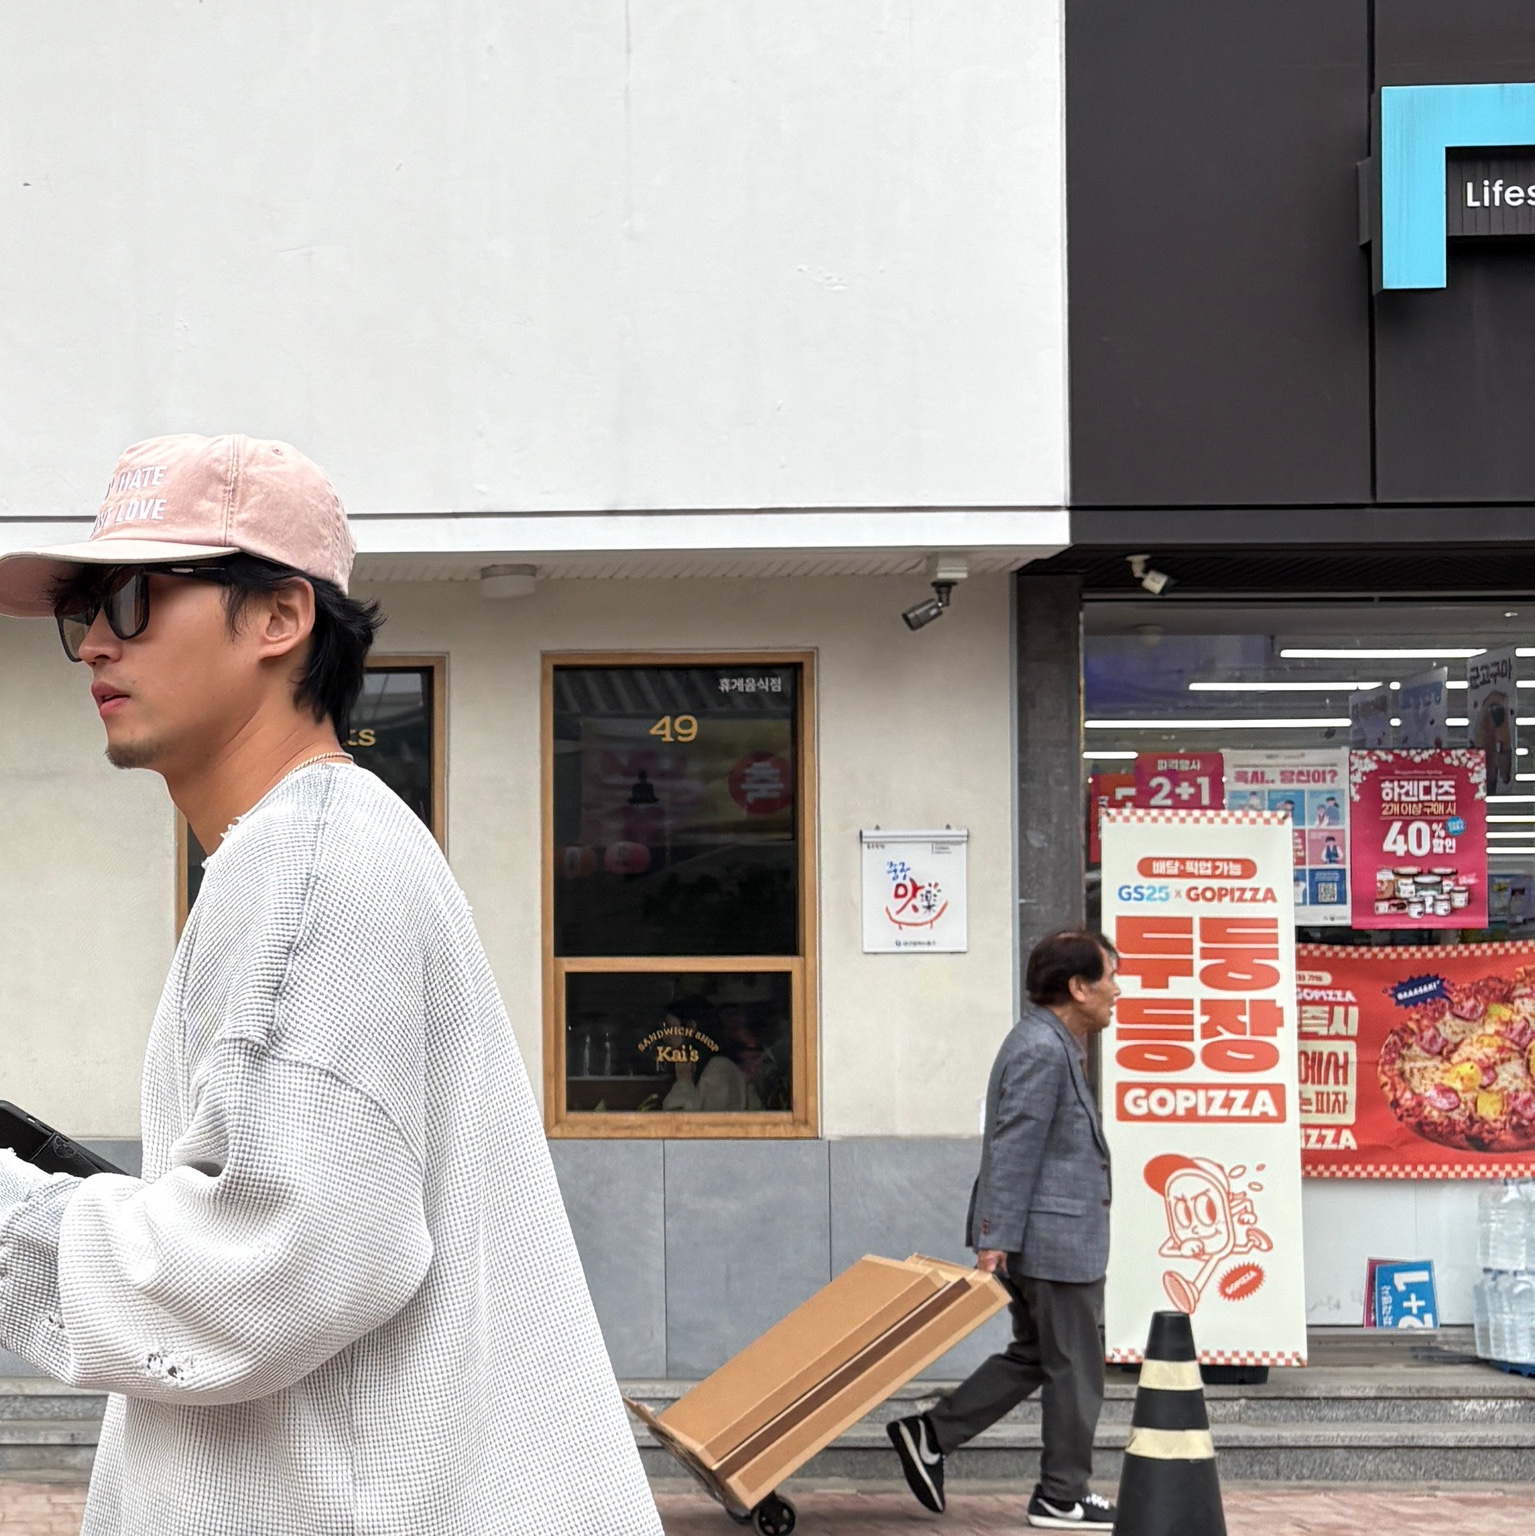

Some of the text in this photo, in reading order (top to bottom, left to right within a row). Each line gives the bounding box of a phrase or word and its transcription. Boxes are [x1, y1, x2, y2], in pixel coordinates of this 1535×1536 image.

[115, 499, 166, 522] LOVE
[718, 677, 782, 693] 휴게음식점
[648, 714, 699, 743] 49
[1148, 775, 1211, 807] 2+1
[1380, 779, 1456, 801] 하겐다즈
[1382, 820, 1446, 857] 40%
[1215, 859, 1242, 877] 가능
[1117, 885, 1170, 903] GS25
[1185, 886, 1278, 903] GOPIZZA
[637, 1026, 720, 1052] SANDWICH SHOP
[1115, 997, 1285, 1074] 등장
[656, 1044, 700, 1063] Kai's
[1123, 1087, 1278, 1118] GOPIZZA
